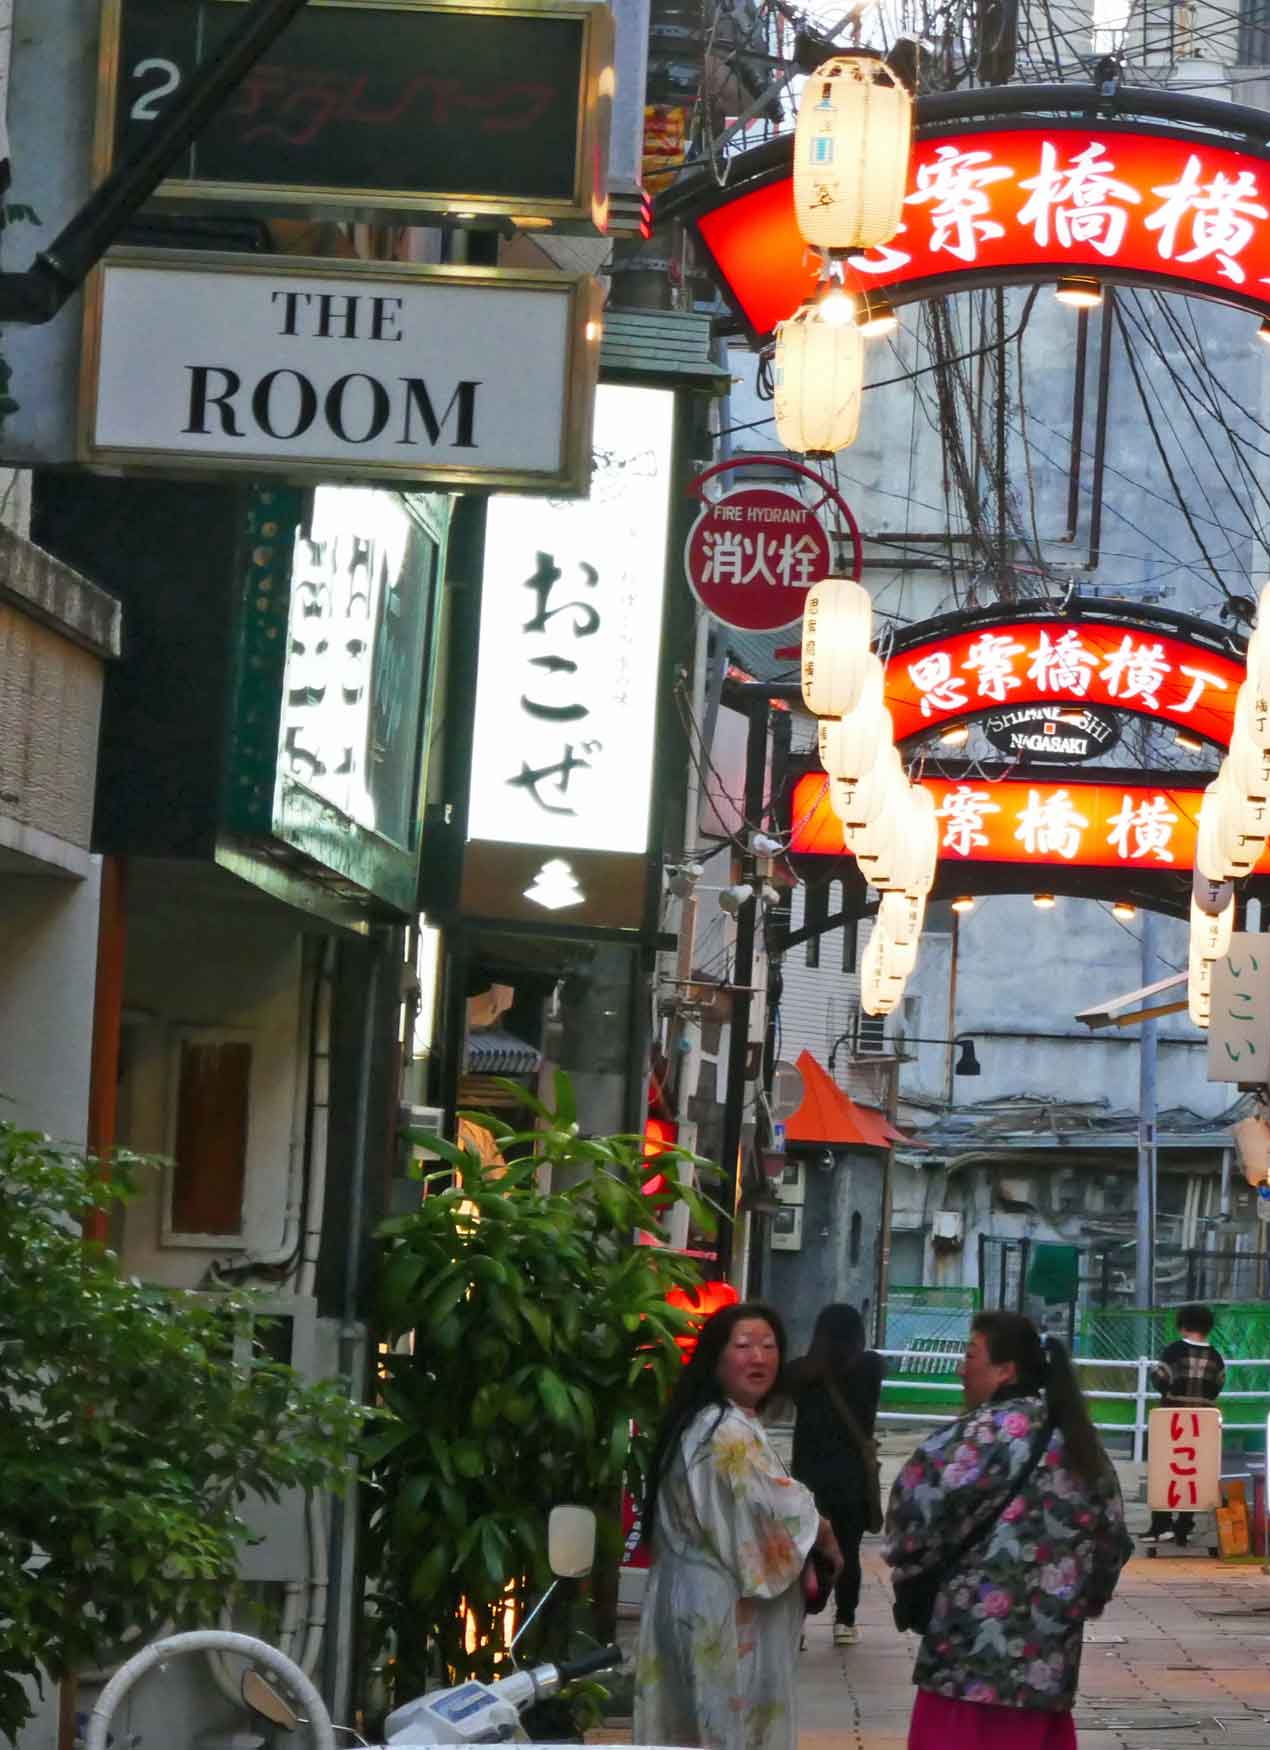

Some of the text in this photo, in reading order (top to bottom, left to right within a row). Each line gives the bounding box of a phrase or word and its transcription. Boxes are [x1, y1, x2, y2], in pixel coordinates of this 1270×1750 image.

[130, 58, 181, 120] 2
[272, 291, 403, 342] THE
[180, 365, 483, 448] ROOM
[714, 506, 808, 523] FIRE HYDRANT
[702, 531, 821, 588] 消火栓
[504, 550, 603, 817] おこぜ
[906, 629, 1228, 718] 思案橋横丁
[1010, 734, 1088, 755] NAGASAKI
[935, 785, 1200, 862] 案橋横
[1225, 953, 1258, 1062] いこい
[1168, 1412, 1200, 1509] いこい
